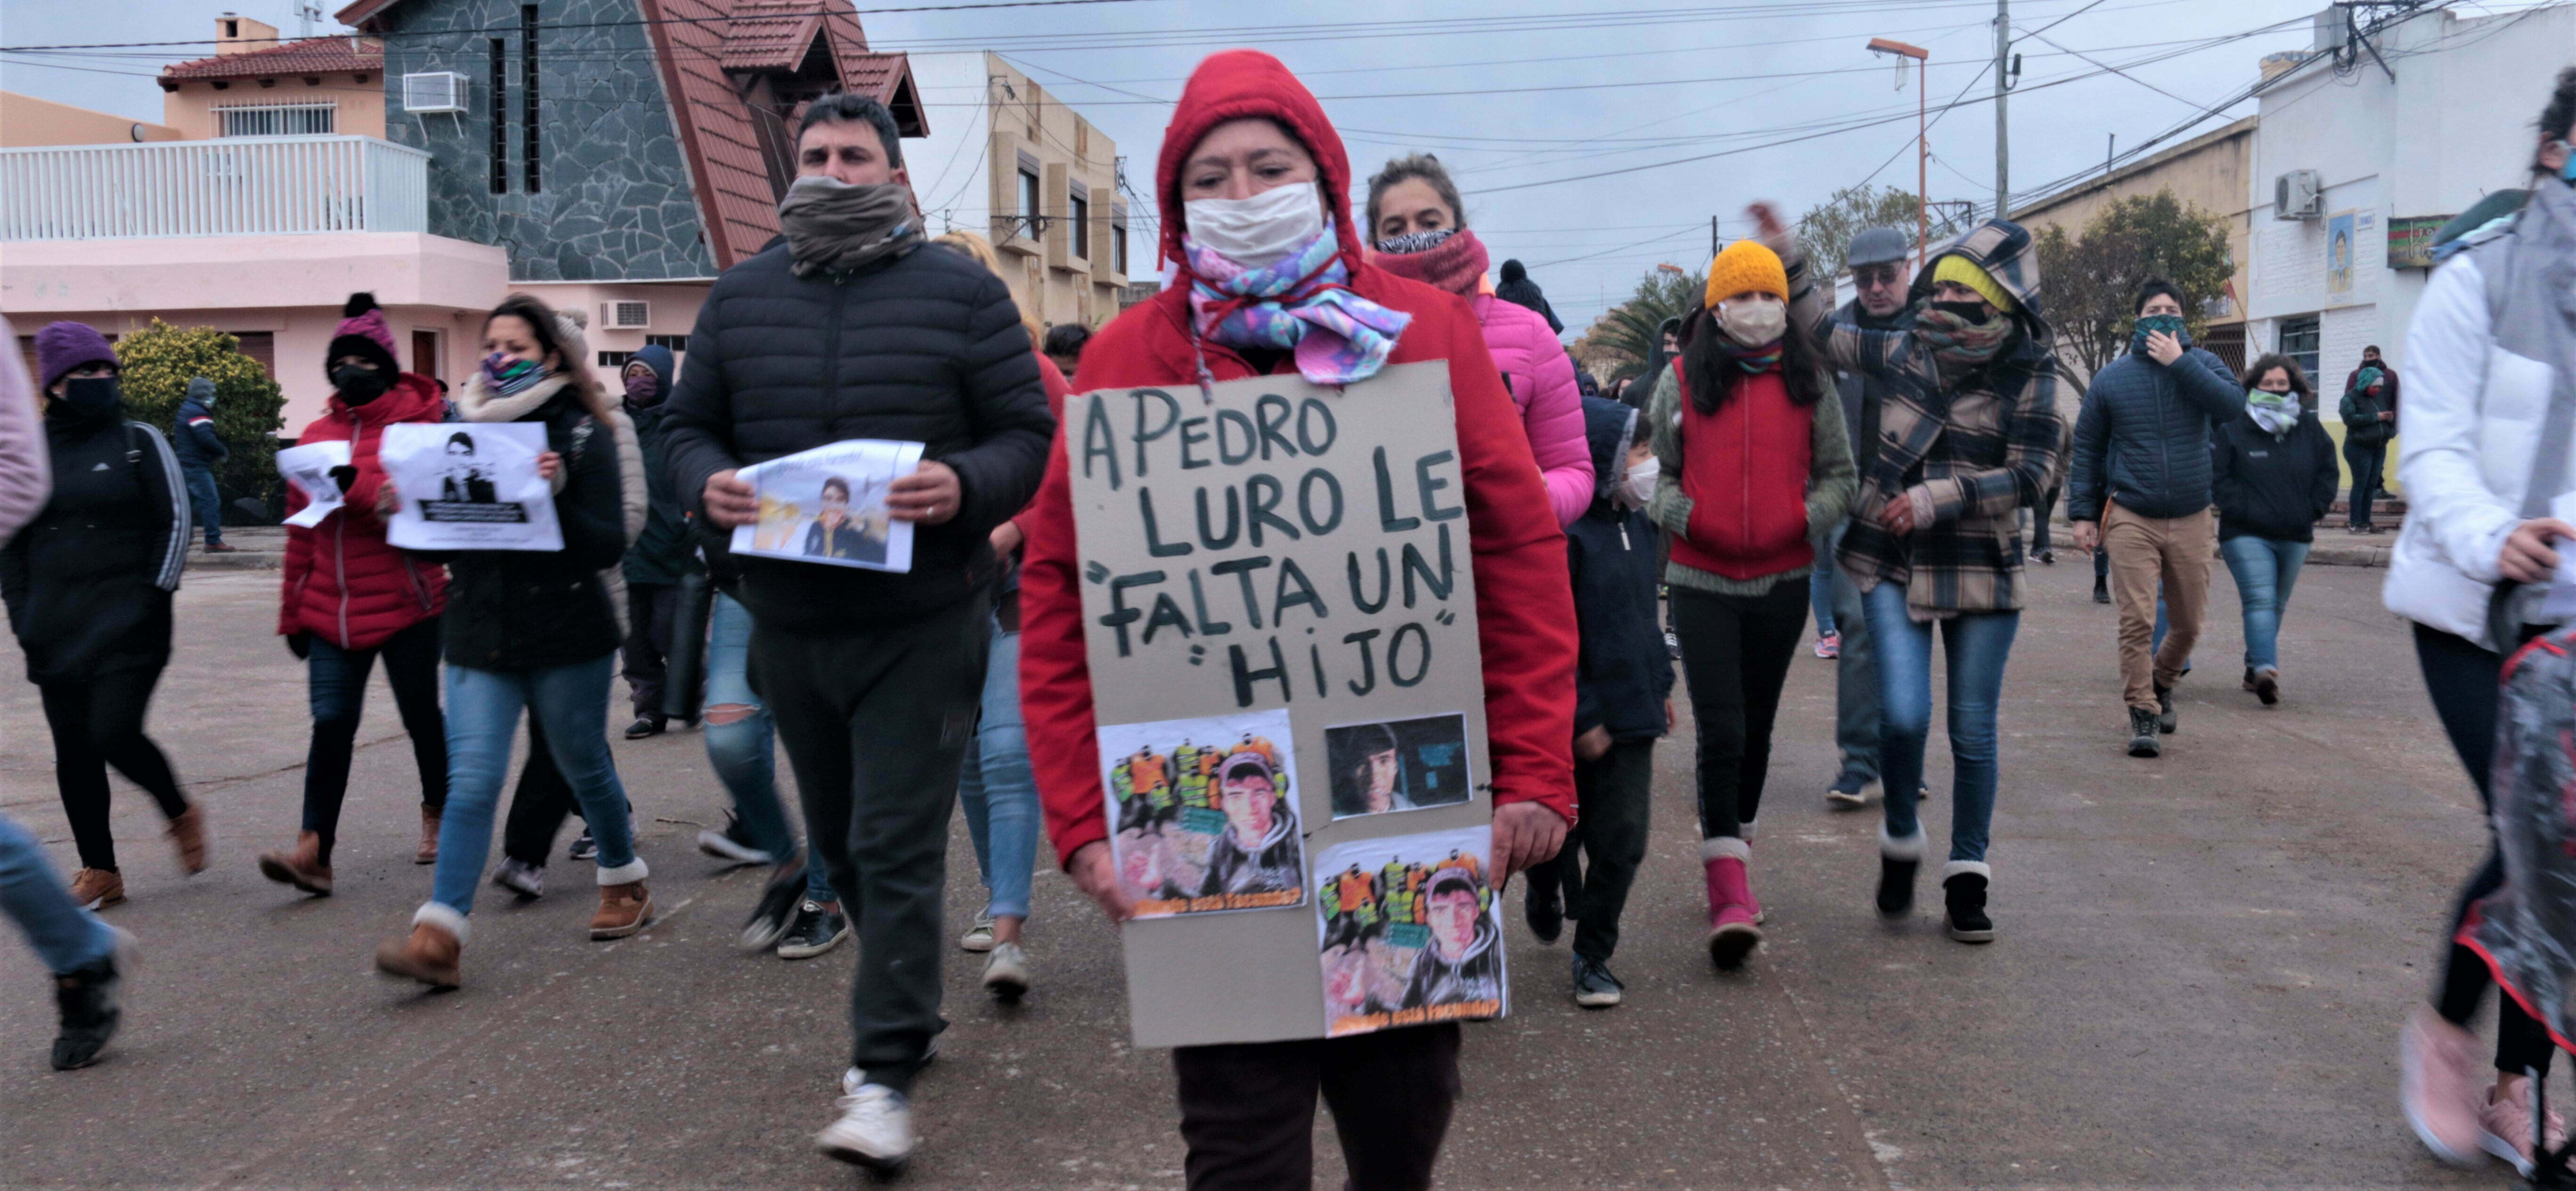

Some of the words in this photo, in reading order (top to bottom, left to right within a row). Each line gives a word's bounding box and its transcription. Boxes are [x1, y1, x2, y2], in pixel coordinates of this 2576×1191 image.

[1084, 395, 1121, 490] A
[1131, 389, 1337, 477] PEDRO
[1140, 469, 1343, 557] LURO
[1373, 446, 1463, 532] LE
[1348, 523, 1454, 614] UN
